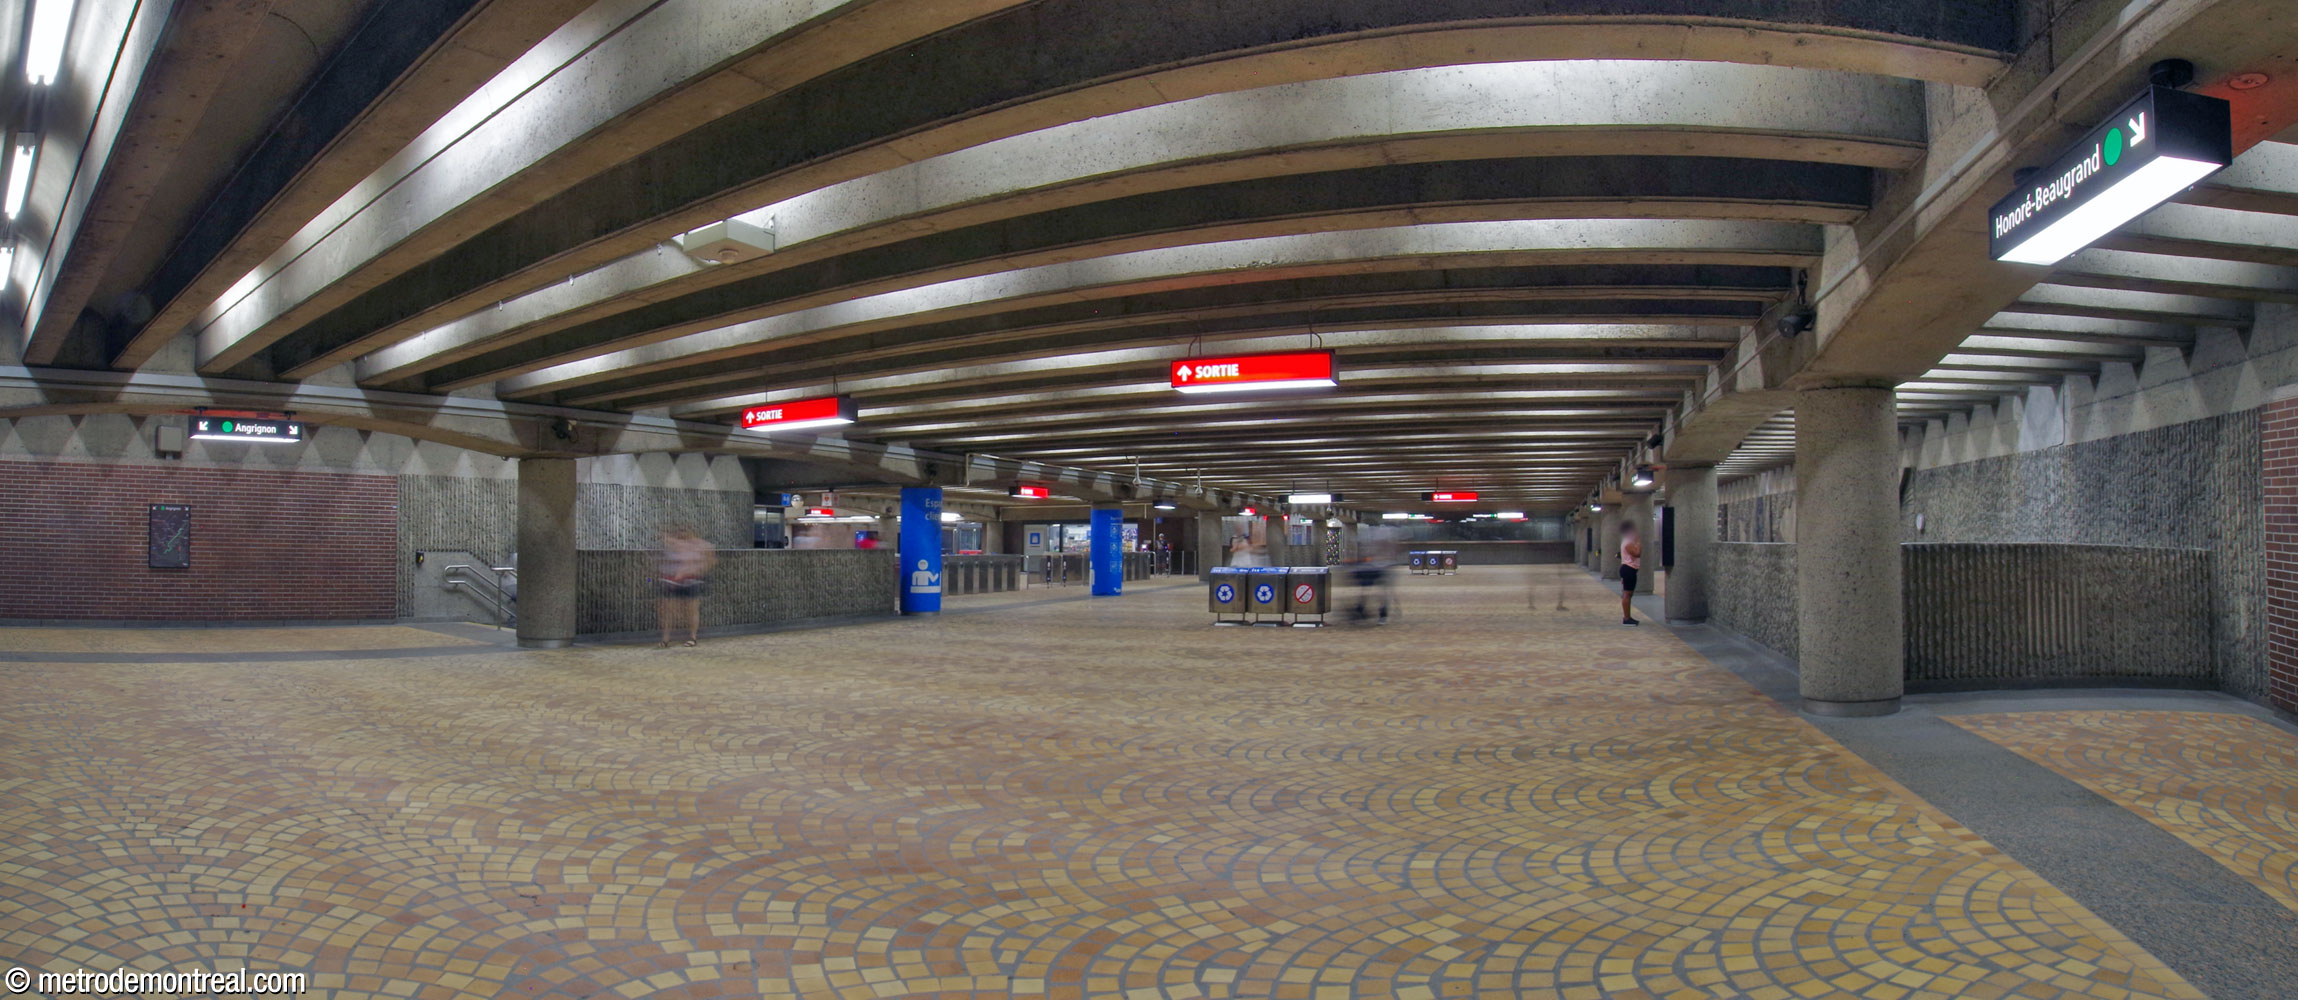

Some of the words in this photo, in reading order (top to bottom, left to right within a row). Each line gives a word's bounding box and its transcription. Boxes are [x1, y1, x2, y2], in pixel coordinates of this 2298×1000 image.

[1995, 143, 2100, 239] Honoré-Beaugrand
[1195, 363, 1239, 379] SORTIE
[756, 409, 783, 421] SORTIE
[235, 423, 277, 434] Angrignon
